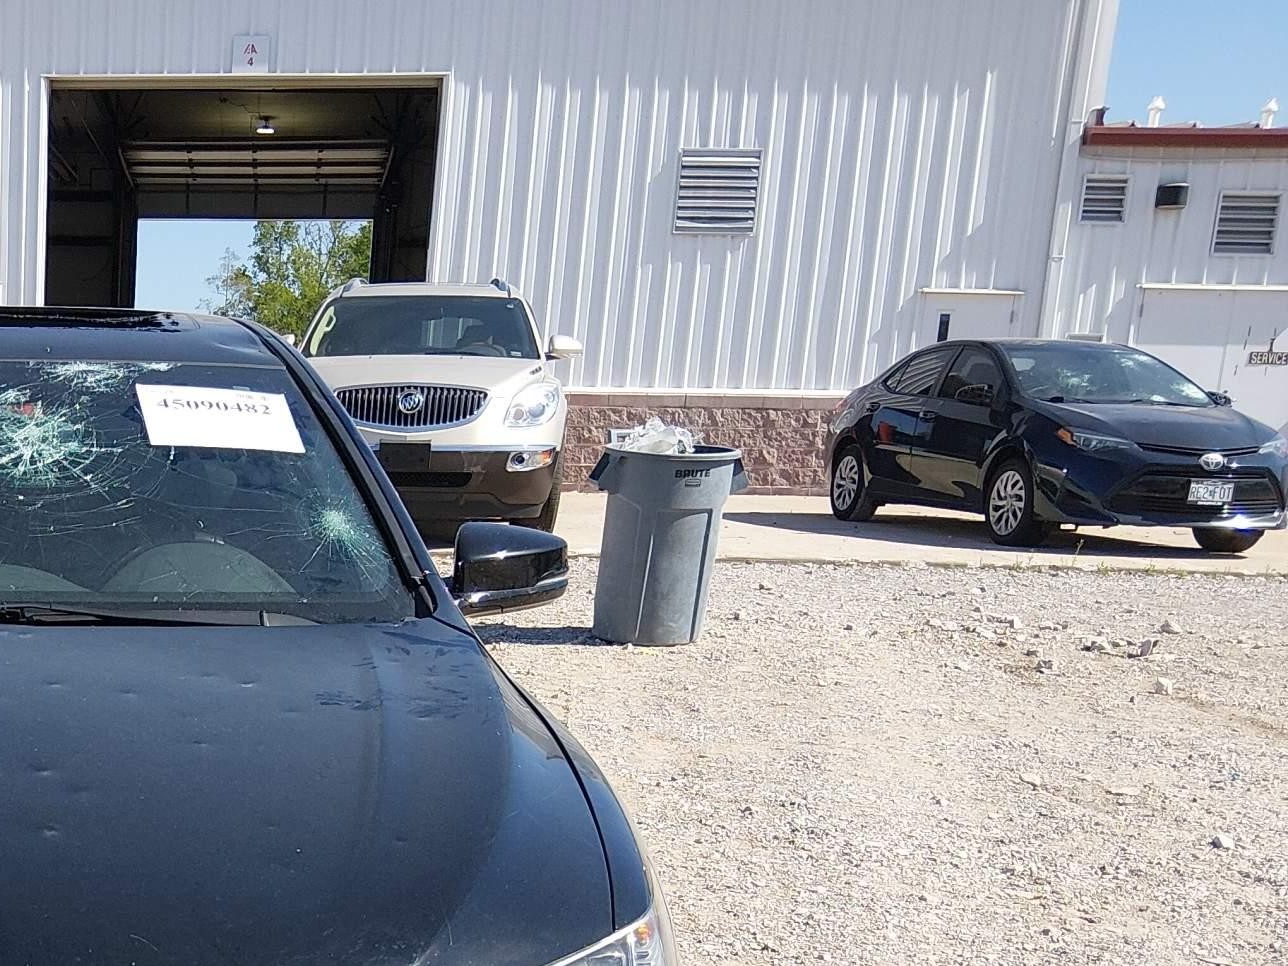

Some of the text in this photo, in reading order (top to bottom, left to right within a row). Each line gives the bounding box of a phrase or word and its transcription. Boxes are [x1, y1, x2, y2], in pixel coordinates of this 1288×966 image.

[247, 57, 254, 66] 4
[1250, 351, 1288, 365] SERVICE
[156, 397, 272, 416] 45090482
[674, 468, 711, 479] BRUTE
